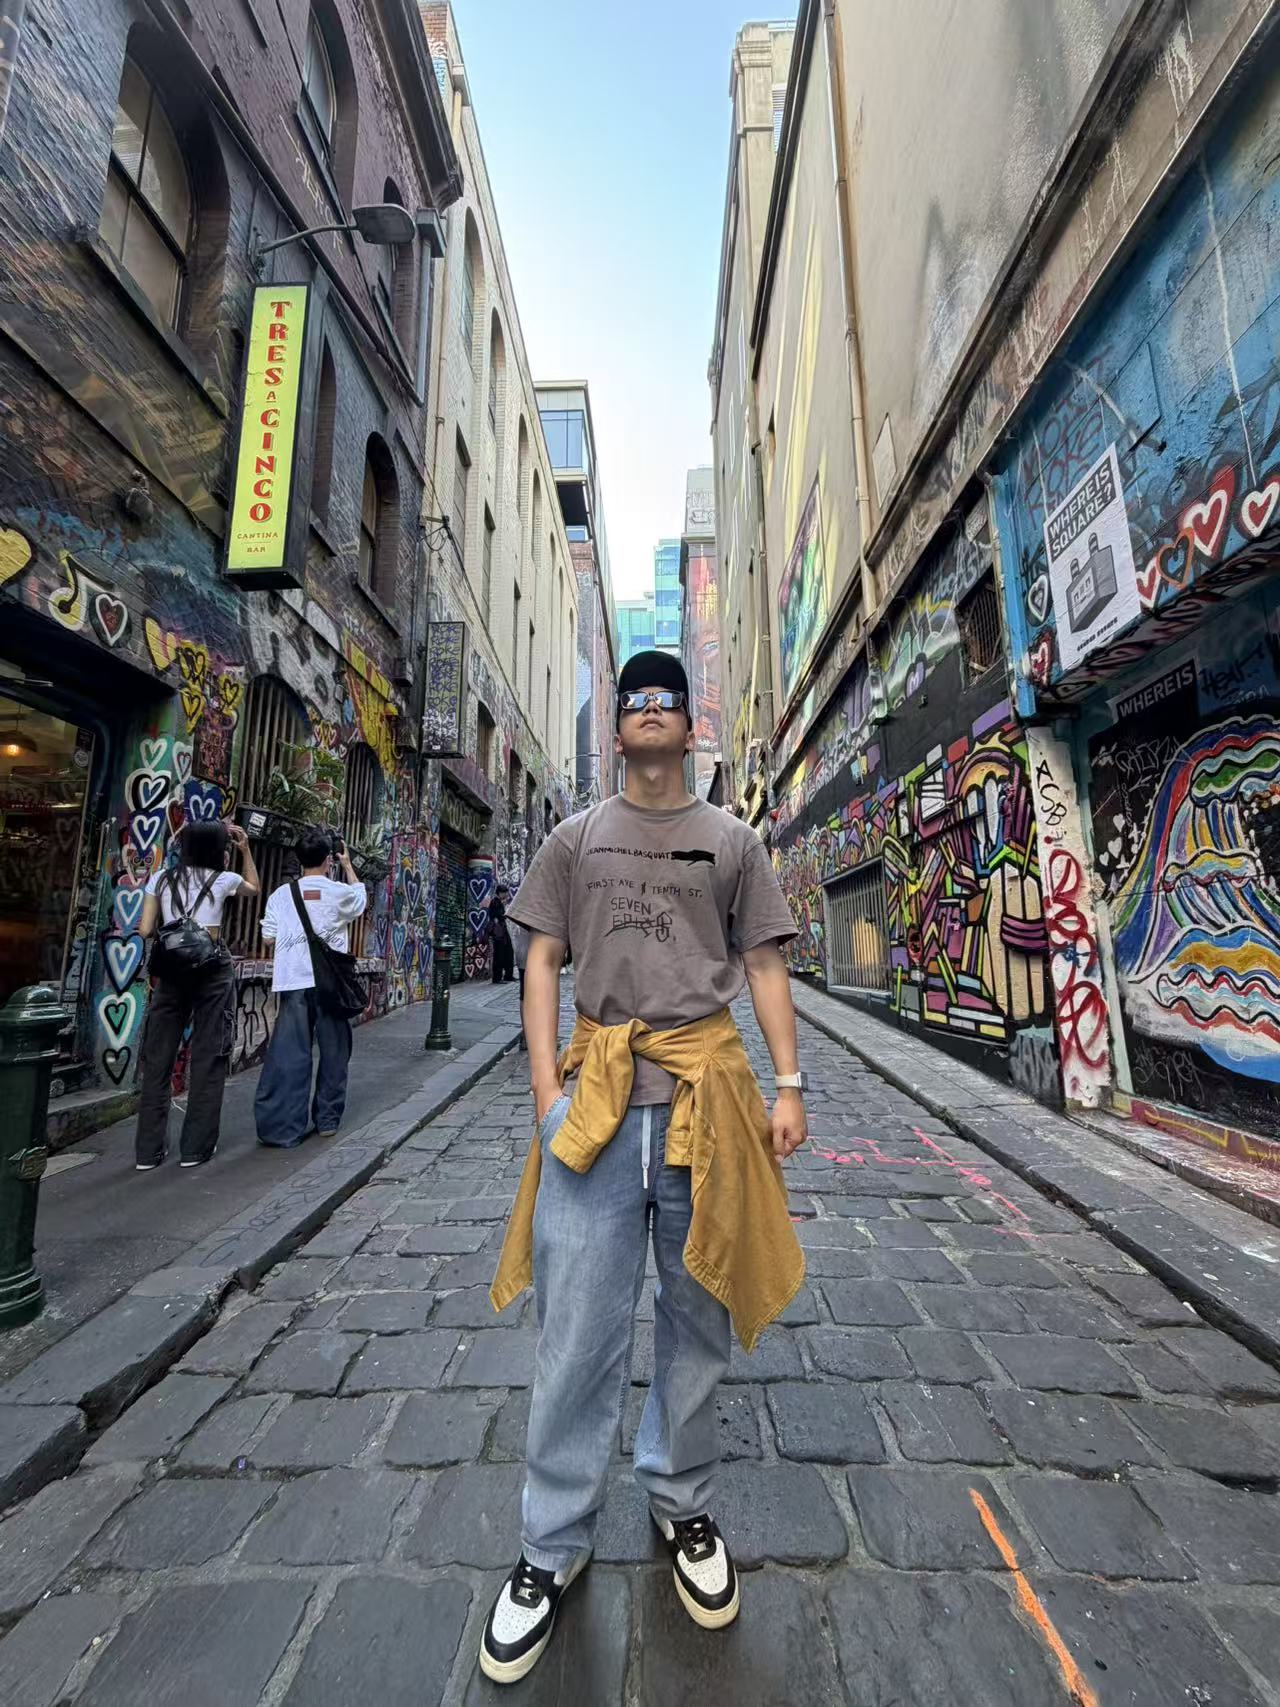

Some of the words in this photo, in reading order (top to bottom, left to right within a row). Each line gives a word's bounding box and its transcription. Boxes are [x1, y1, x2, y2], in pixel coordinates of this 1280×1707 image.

[264, 301, 293, 387] TRES
[266, 391, 277, 402] A
[249, 408, 281, 523] CINCO
[1052, 483, 1113, 557] SQUARE?
[237, 531, 279, 540] CANTINA
[587, 879, 615, 892] FIRST
[652, 885, 681, 897] TENTH
[610, 896, 652, 915] SEVEN
